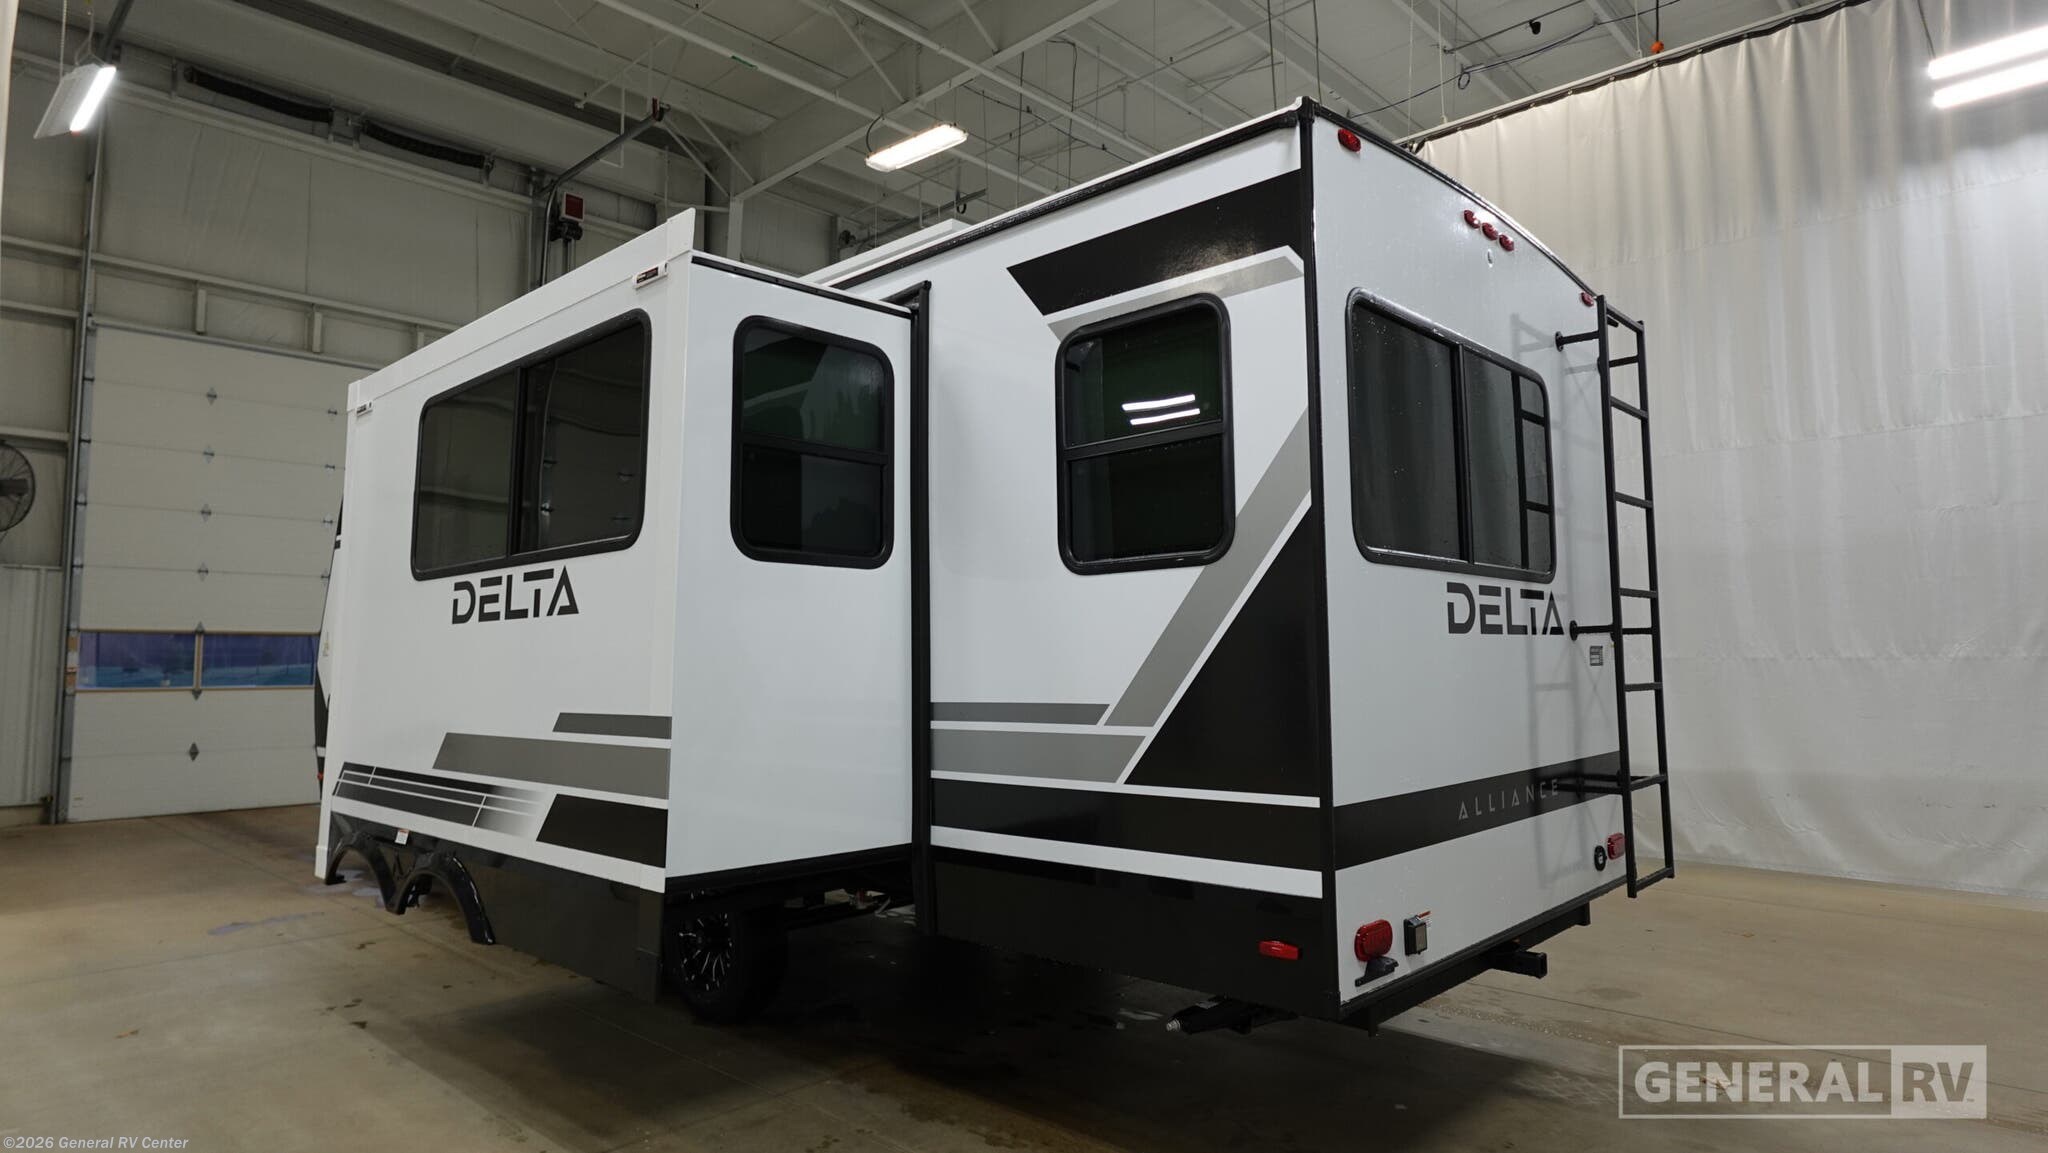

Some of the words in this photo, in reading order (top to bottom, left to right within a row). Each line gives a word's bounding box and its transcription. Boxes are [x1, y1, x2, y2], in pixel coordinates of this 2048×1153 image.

[452, 565, 579, 624] DELTA
[1447, 582, 1564, 635] DELTA
[1458, 779, 1559, 820] ALLIANCE
